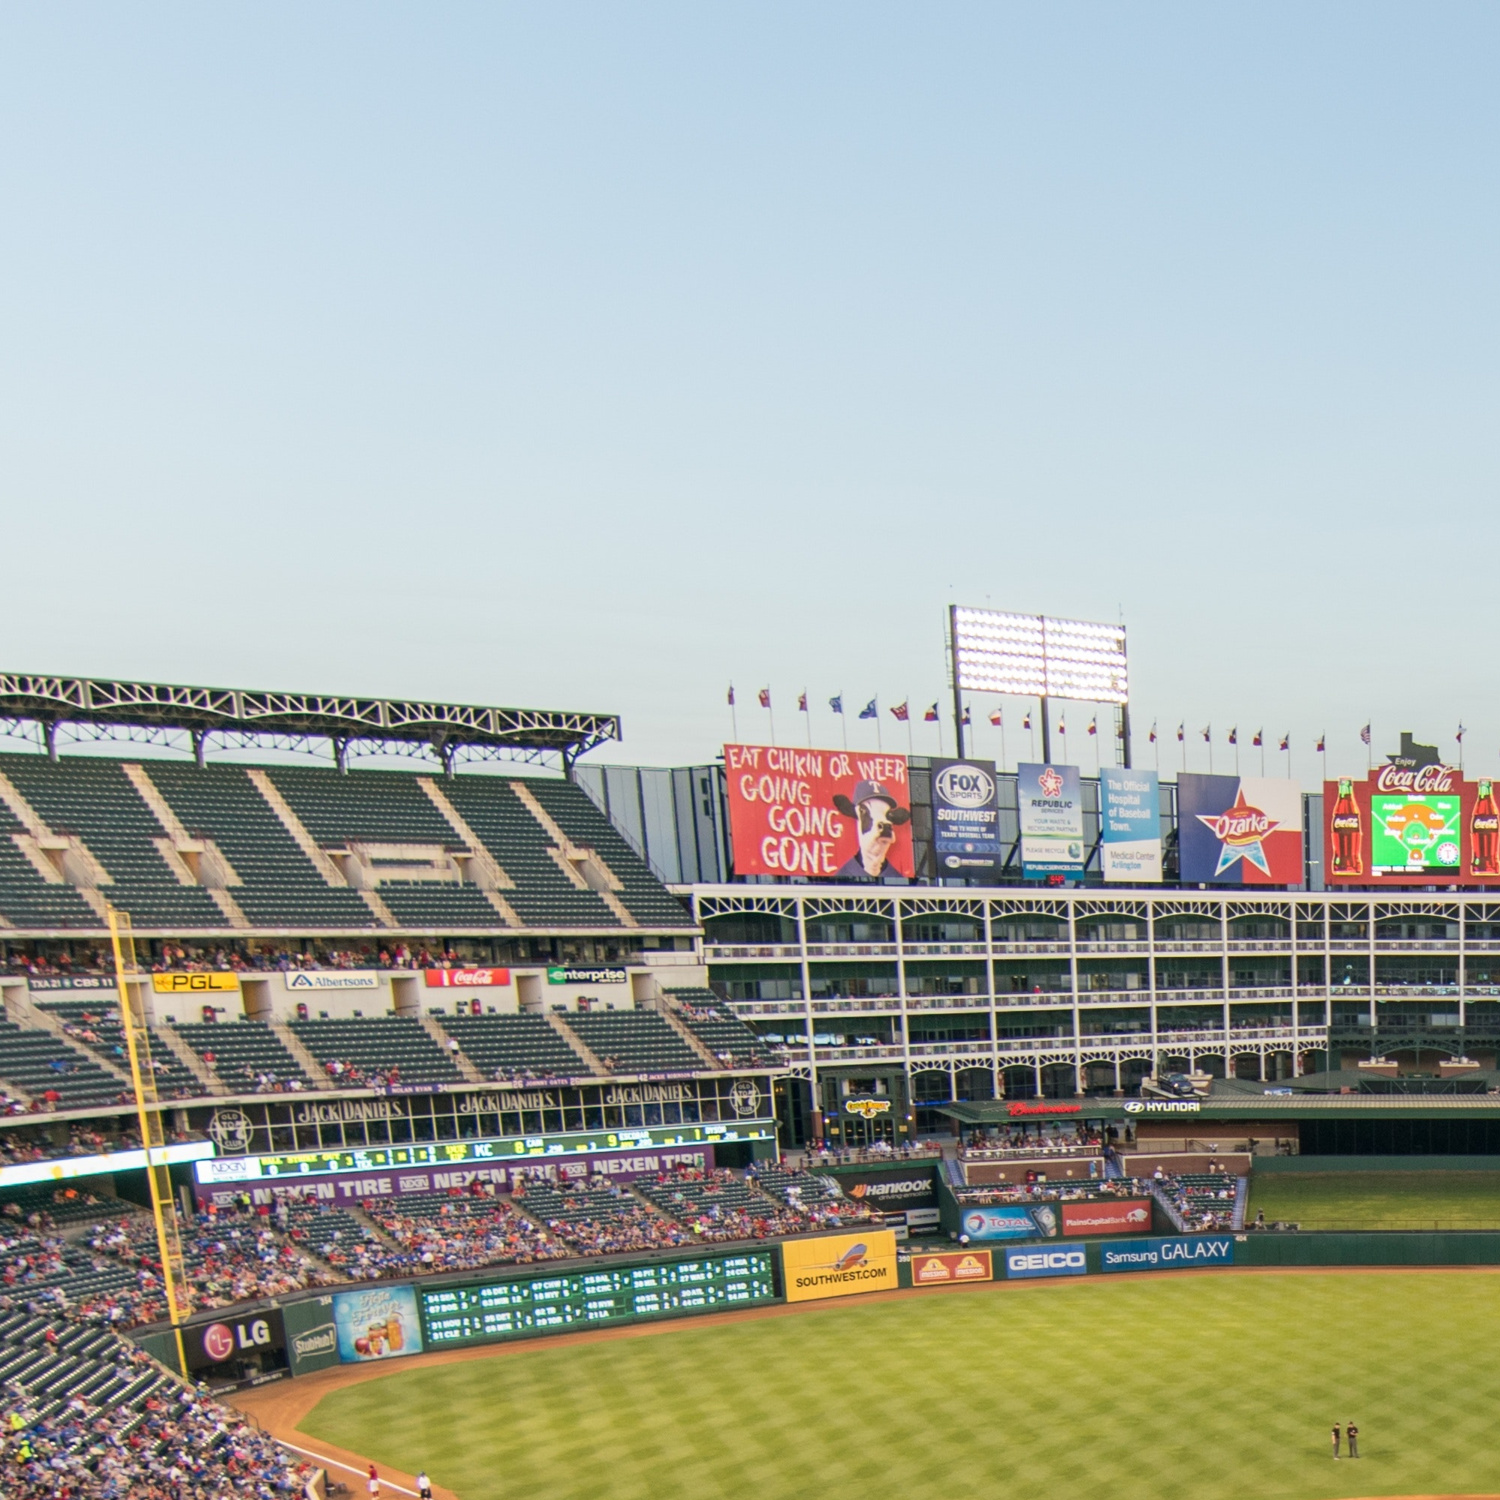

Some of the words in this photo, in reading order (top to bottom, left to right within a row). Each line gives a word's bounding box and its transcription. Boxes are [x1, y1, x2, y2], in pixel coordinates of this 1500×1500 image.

[728, 746, 762, 769] EAT
[767, 748, 822, 778] CHIKIN
[829, 754, 853, 780] OR
[857, 758, 906, 784] WEER
[1395, 757, 1416, 766] Enjoy
[949, 774, 981, 792] FOX
[1107, 780, 1121, 790] The
[1123, 780, 1150, 792] Official
[1378, 764, 1453, 793] Coca-Cola
[740, 774, 812, 806] GOING
[868, 780, 881, 793] T
[950, 791, 982, 799] SPORTS
[1108, 793, 1140, 806] Hospital
[1031, 799, 1072, 808] REPUBLIC
[937, 808, 996, 822] SOUTHWEST
[1108, 807, 1118, 817] of
[1118, 808, 1151, 819] Baseball
[768, 805, 843, 838] GOING
[1109, 820, 1132, 832] Town.
[1215, 813, 1268, 839] Ozarka
[761, 836, 838, 874] GONE
[1110, 850, 1134, 860] Medical
[1135, 851, 1155, 861] Center
[1112, 861, 1141, 871] Arlington
[172, 975, 222, 990] PGL
[314, 976, 374, 987] Albertsons
[552, 968, 626, 983] enterprise
[606, 1085, 640, 1104] JACK
[460, 1094, 498, 1113] JACK
[1006, 1101, 1081, 1116] Budweiser
[1147, 1102, 1200, 1112] HYUNDAI
[298, 1102, 340, 1123] JACK
[514, 1141, 524, 1154] 8
[607, 1135, 617, 1147] 9
[473, 1144, 493, 1158] KC
[594, 1155, 659, 1174] NEXEN
[339, 1178, 392, 1197] TIRE
[989, 1217, 1032, 1227] TOTAL
[1105, 1251, 1158, 1264] Samsung
[1161, 1242, 1229, 1260] GALAXY
[1009, 1252, 1085, 1271] GEICO
[796, 1267, 887, 1288] SOUTHWEST.COM
[920, 1269, 948, 1279] mission
[956, 1266, 984, 1276] mission
[237, 1319, 271, 1349] LG
[296, 1330, 334, 1354] StubHub!
